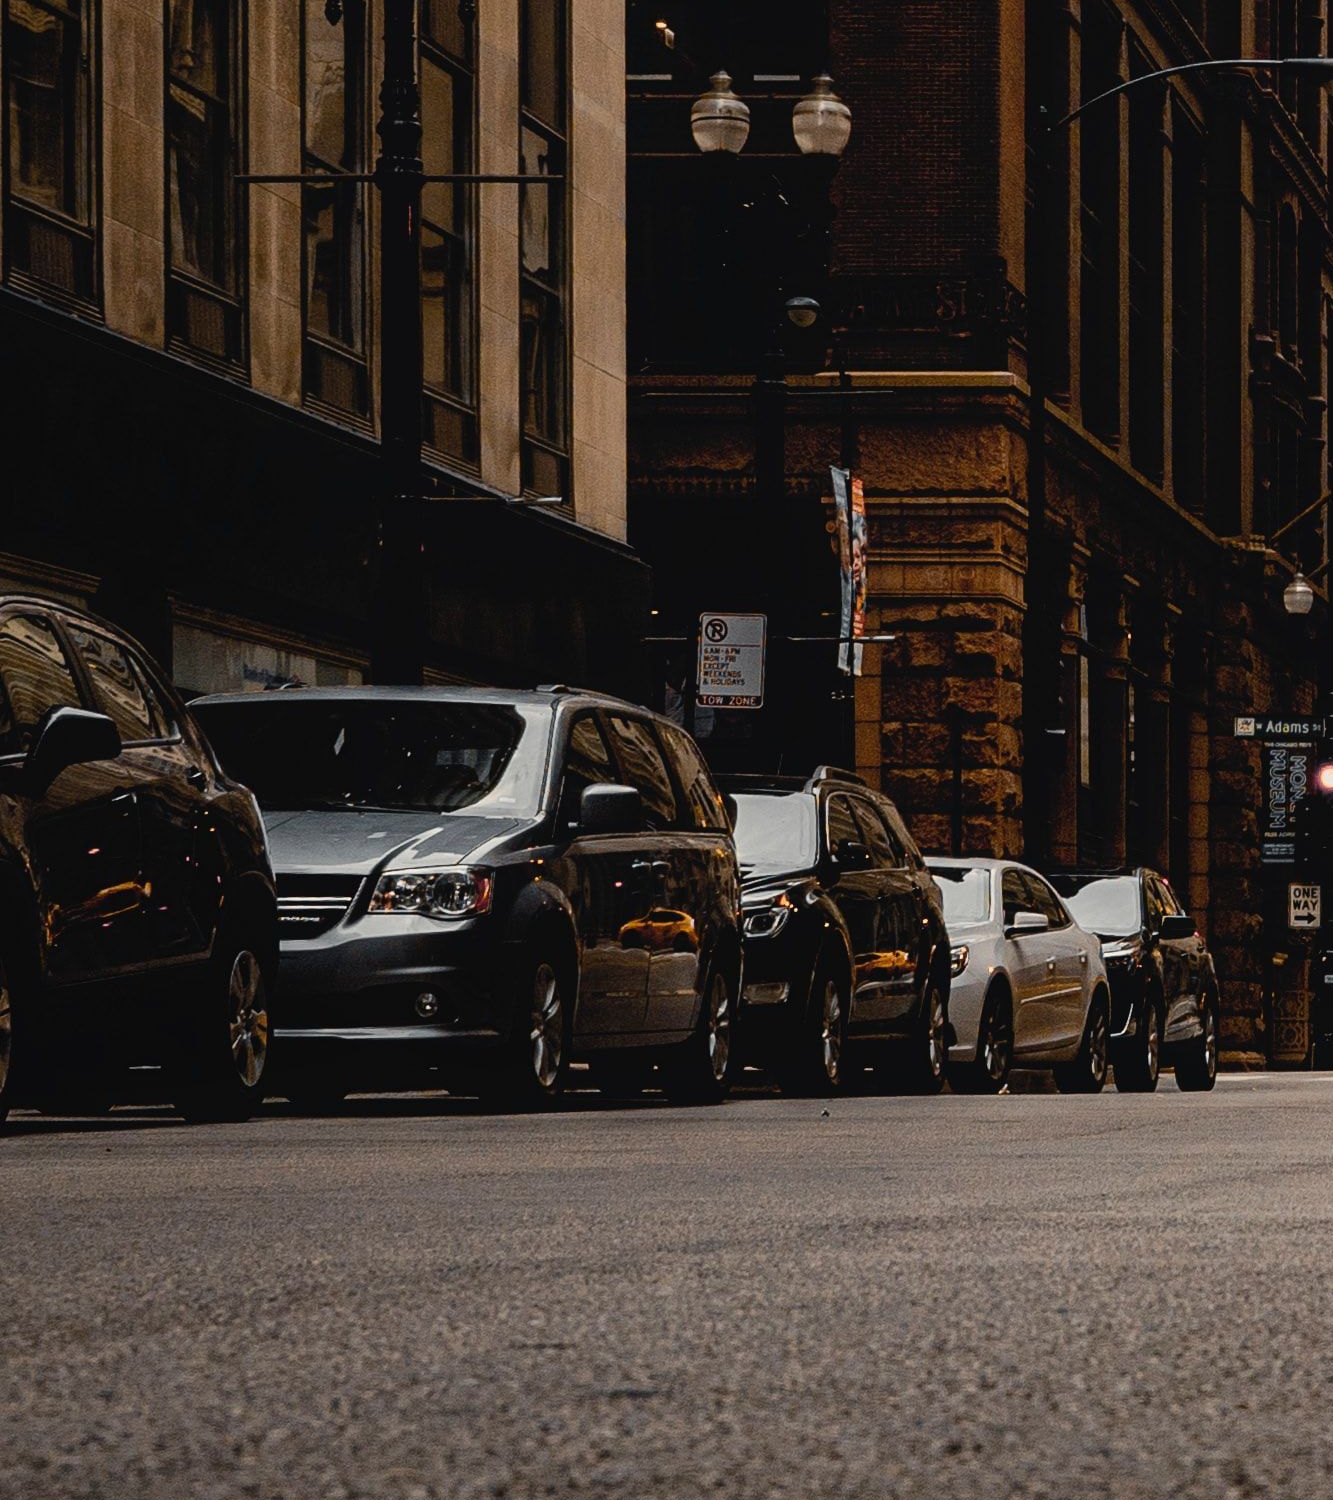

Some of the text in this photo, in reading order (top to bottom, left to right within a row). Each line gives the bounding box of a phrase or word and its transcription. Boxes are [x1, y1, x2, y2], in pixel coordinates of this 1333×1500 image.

[702, 695, 757, 706] TOW ZONE
[1265, 720, 1309, 733] Adams
[1270, 750, 1286, 829] MUSEUM
[1293, 888, 1318, 899] ONE
[1293, 900, 1318, 911] WAY
